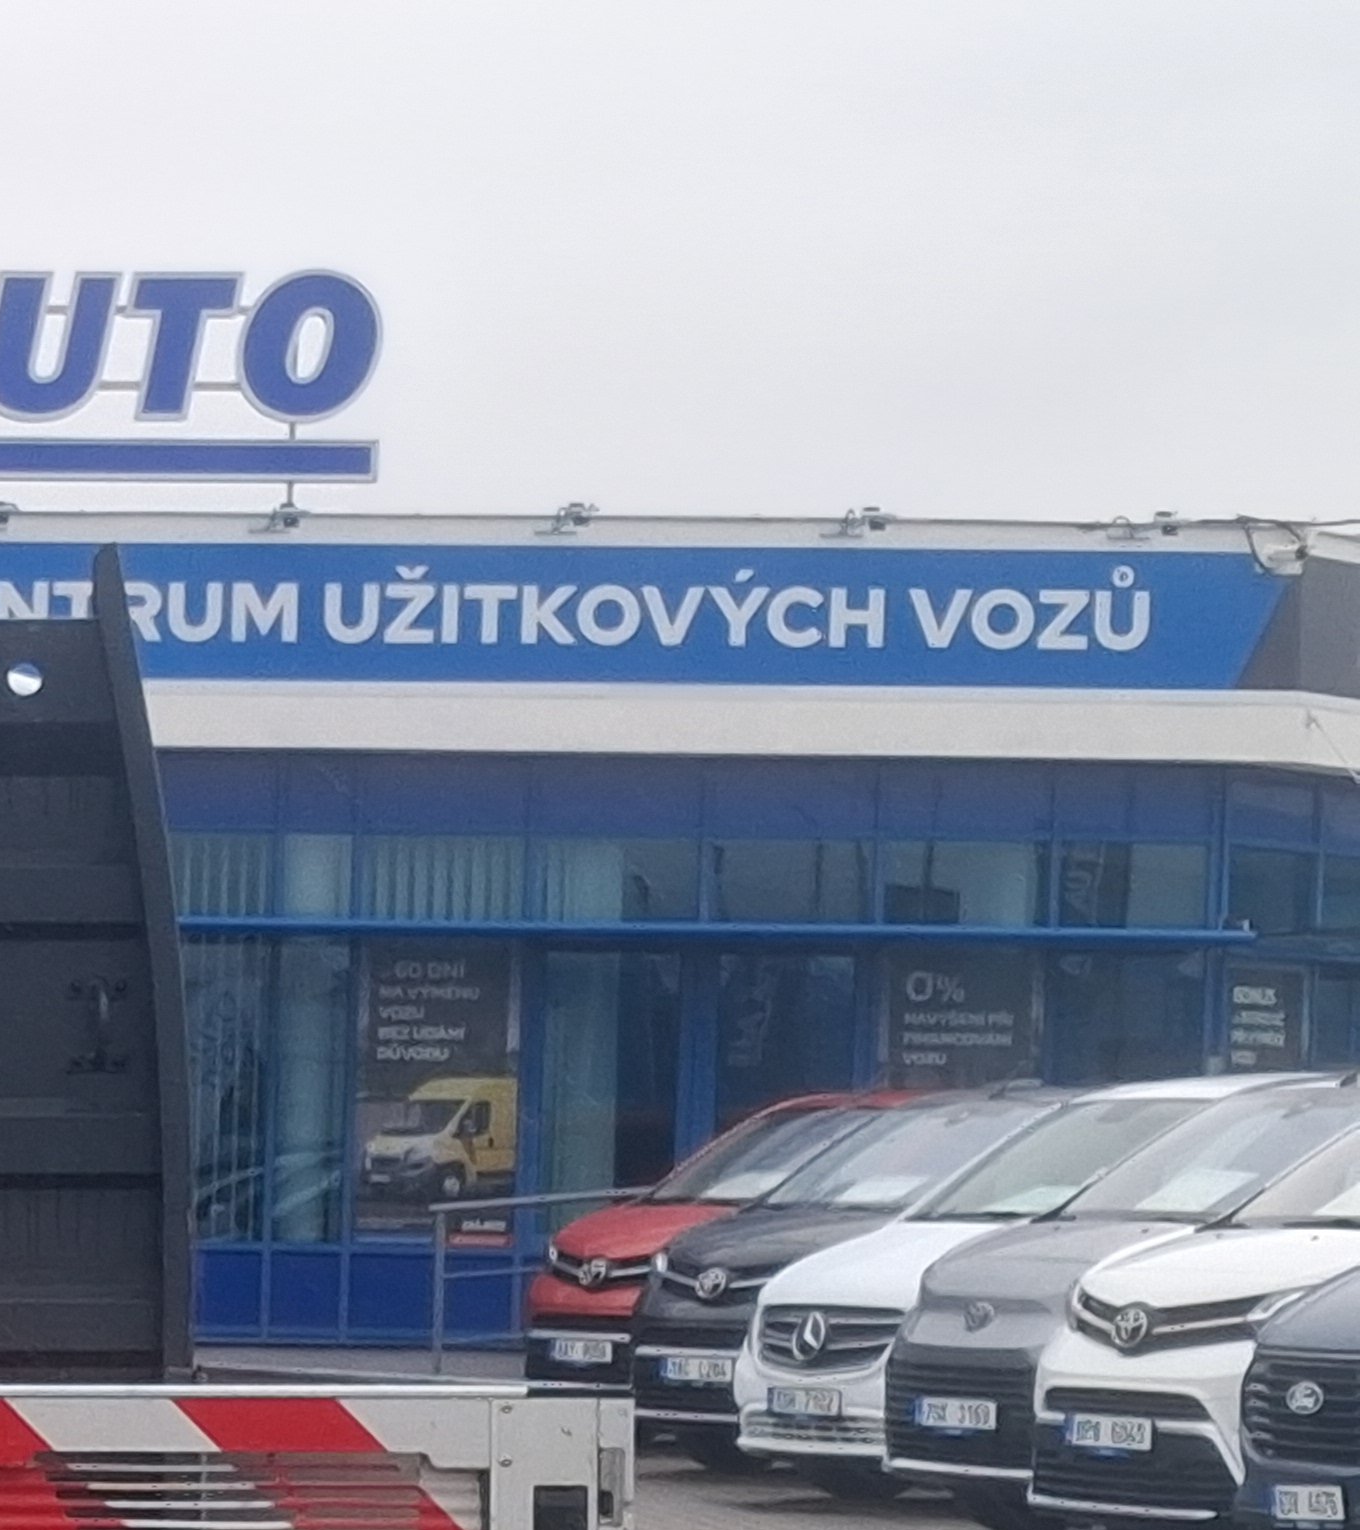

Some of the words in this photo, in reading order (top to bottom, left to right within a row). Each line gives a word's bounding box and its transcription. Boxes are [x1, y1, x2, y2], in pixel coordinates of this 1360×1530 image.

[324, 565, 886, 648] UŽITKOVÝCH
[909, 565, 1152, 651] VOZŮ
[905, 969, 965, 1002] 0%
